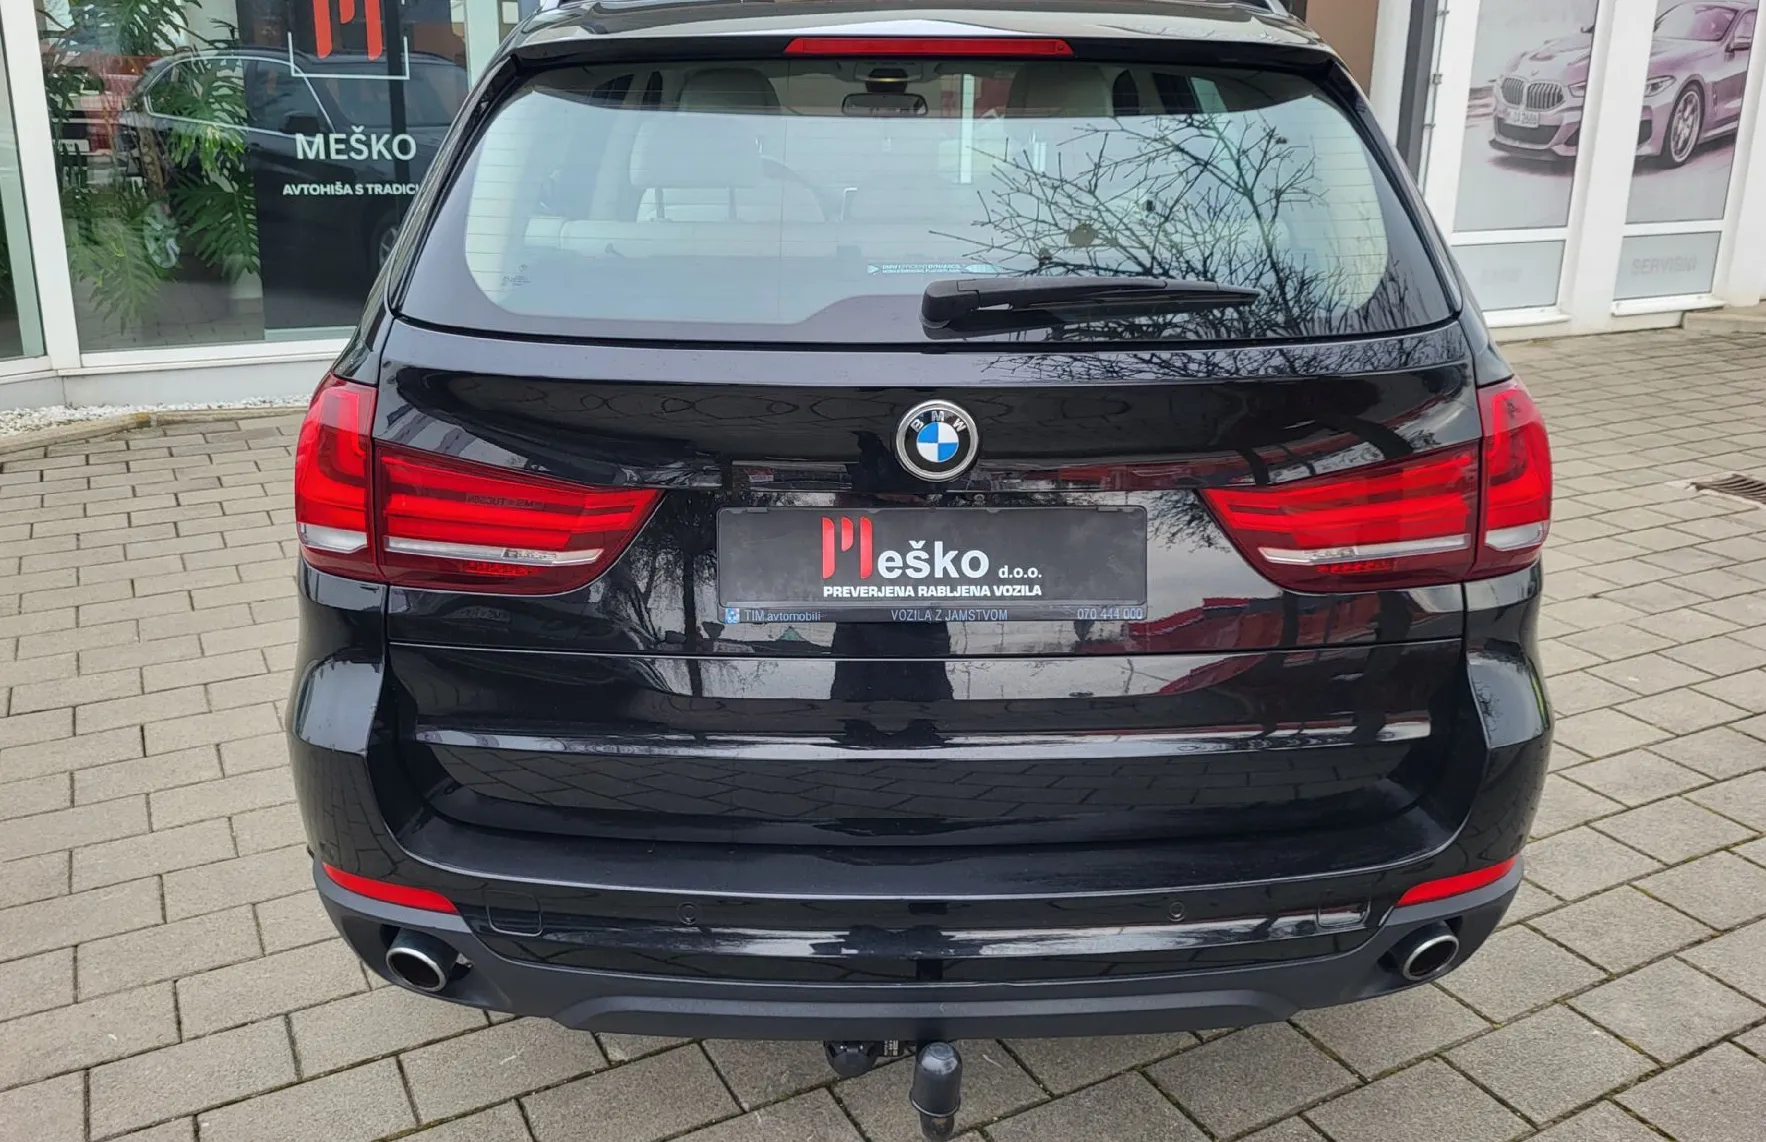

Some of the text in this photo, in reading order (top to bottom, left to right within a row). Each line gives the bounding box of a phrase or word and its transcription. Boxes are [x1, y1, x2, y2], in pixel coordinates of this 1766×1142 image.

[295, 125, 417, 160] MEŠKO
[283, 181, 353, 196] AVTOHIŠA
[354, 183, 364, 195] S
[910, 410, 967, 433] BMW
[998, 565, 1043, 579] d.o.o.
[823, 585, 1043, 598] PREVERJENA RABLJENA VOZILA
[891, 609, 932, 621] VOZILA
[935, 609, 943, 621] Z
[945, 609, 1008, 621] JAMSTVOM
[1077, 608, 1097, 620] 070
[1099, 608, 1120, 620] 444
[1122, 608, 1144, 620] 000
